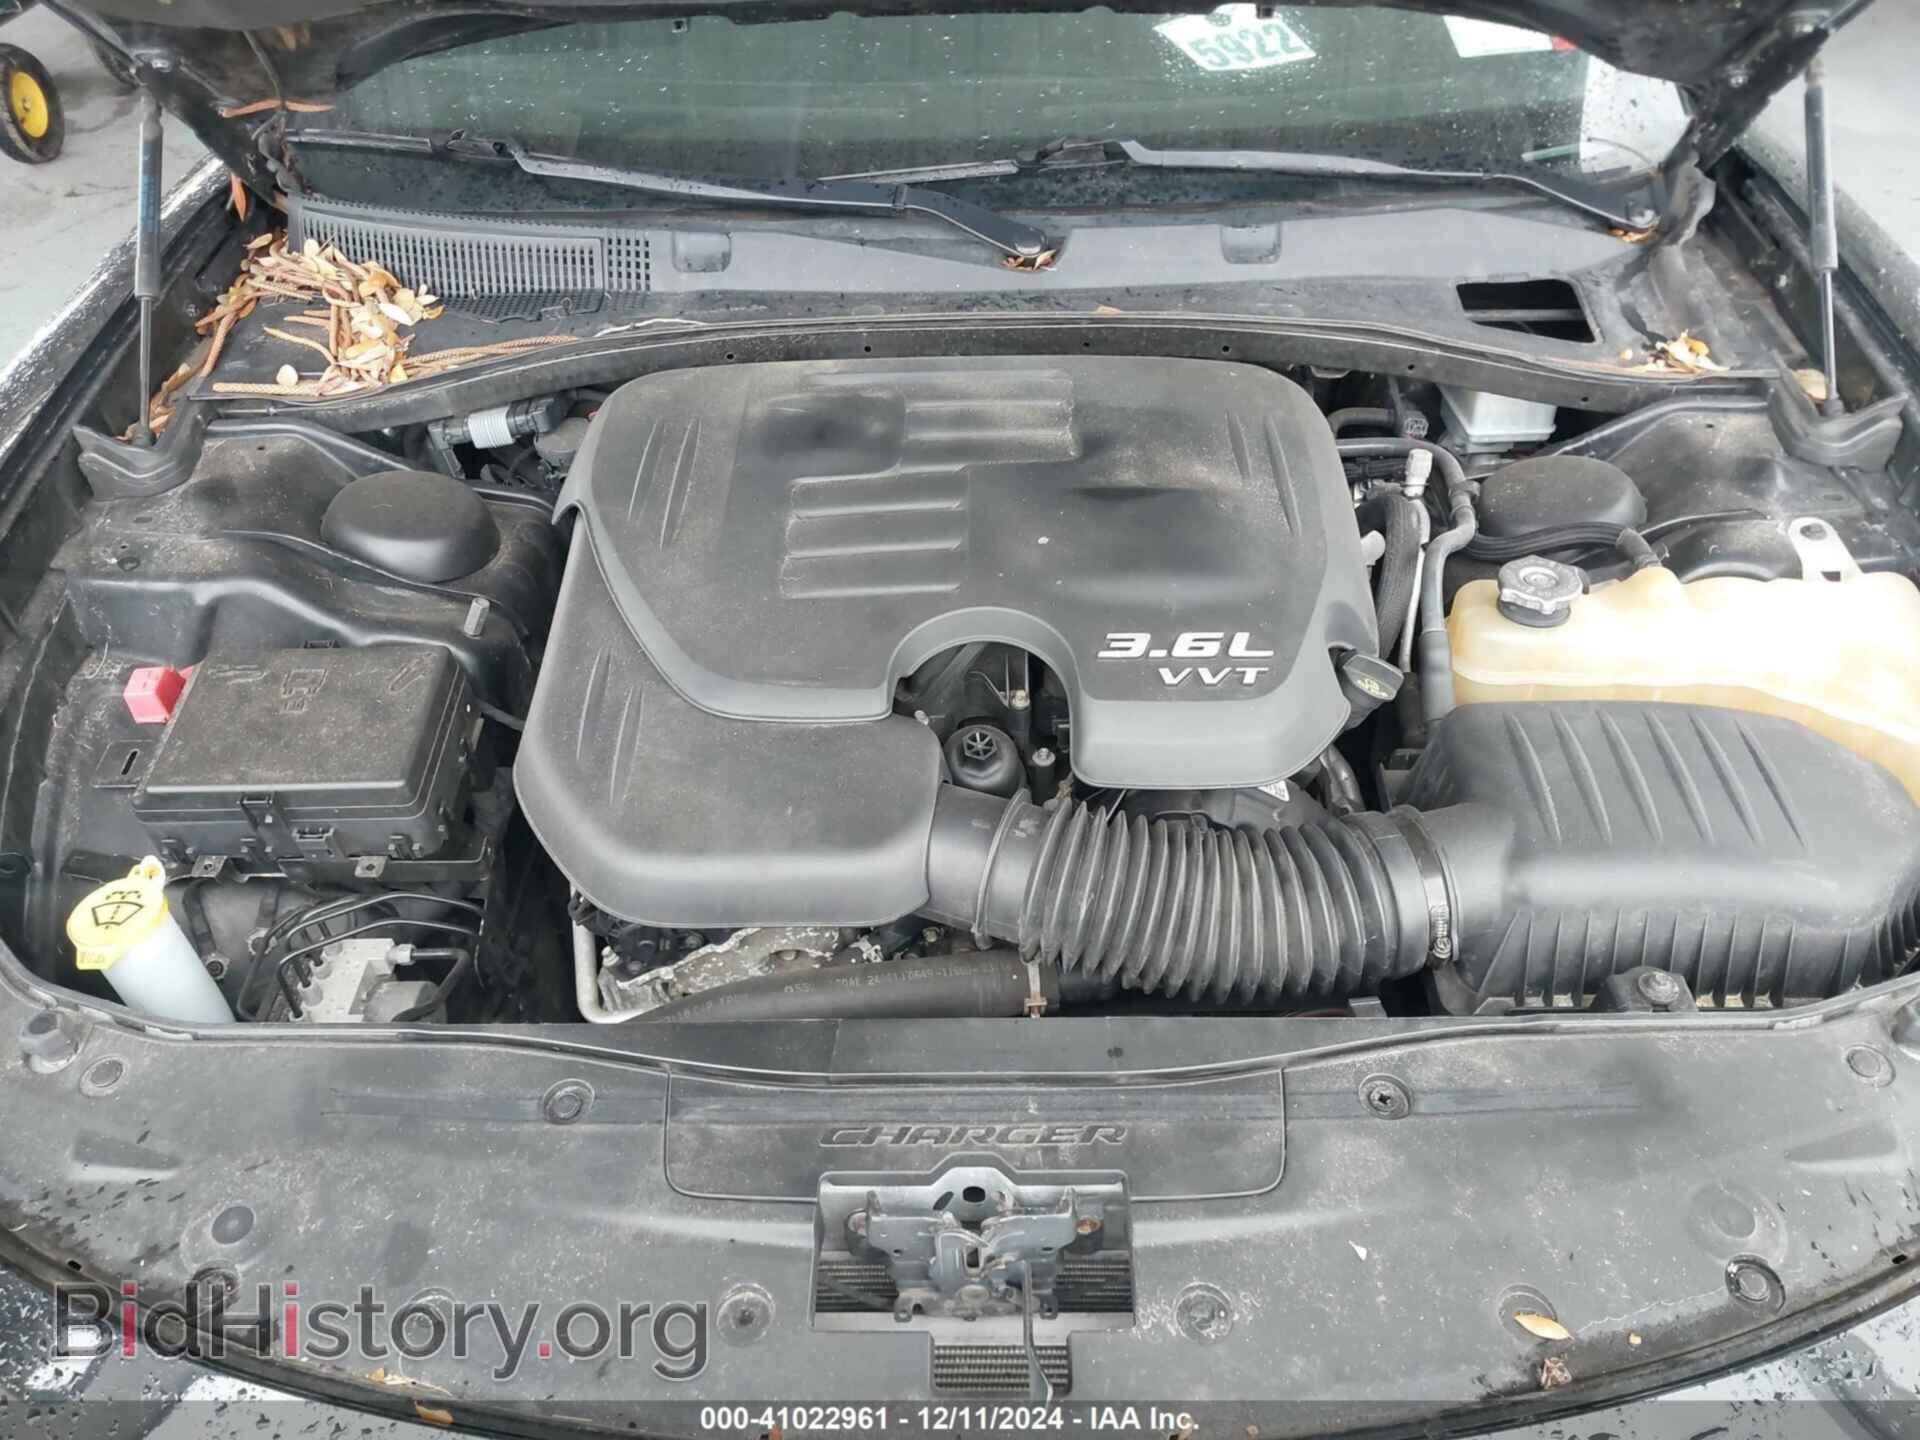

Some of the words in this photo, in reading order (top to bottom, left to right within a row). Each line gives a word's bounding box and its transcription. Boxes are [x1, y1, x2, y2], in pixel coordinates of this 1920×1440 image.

[1097, 632, 1275, 658] 3.6L
[1158, 667, 1269, 685] VVT
[819, 1124, 1128, 1147] CHARGER
